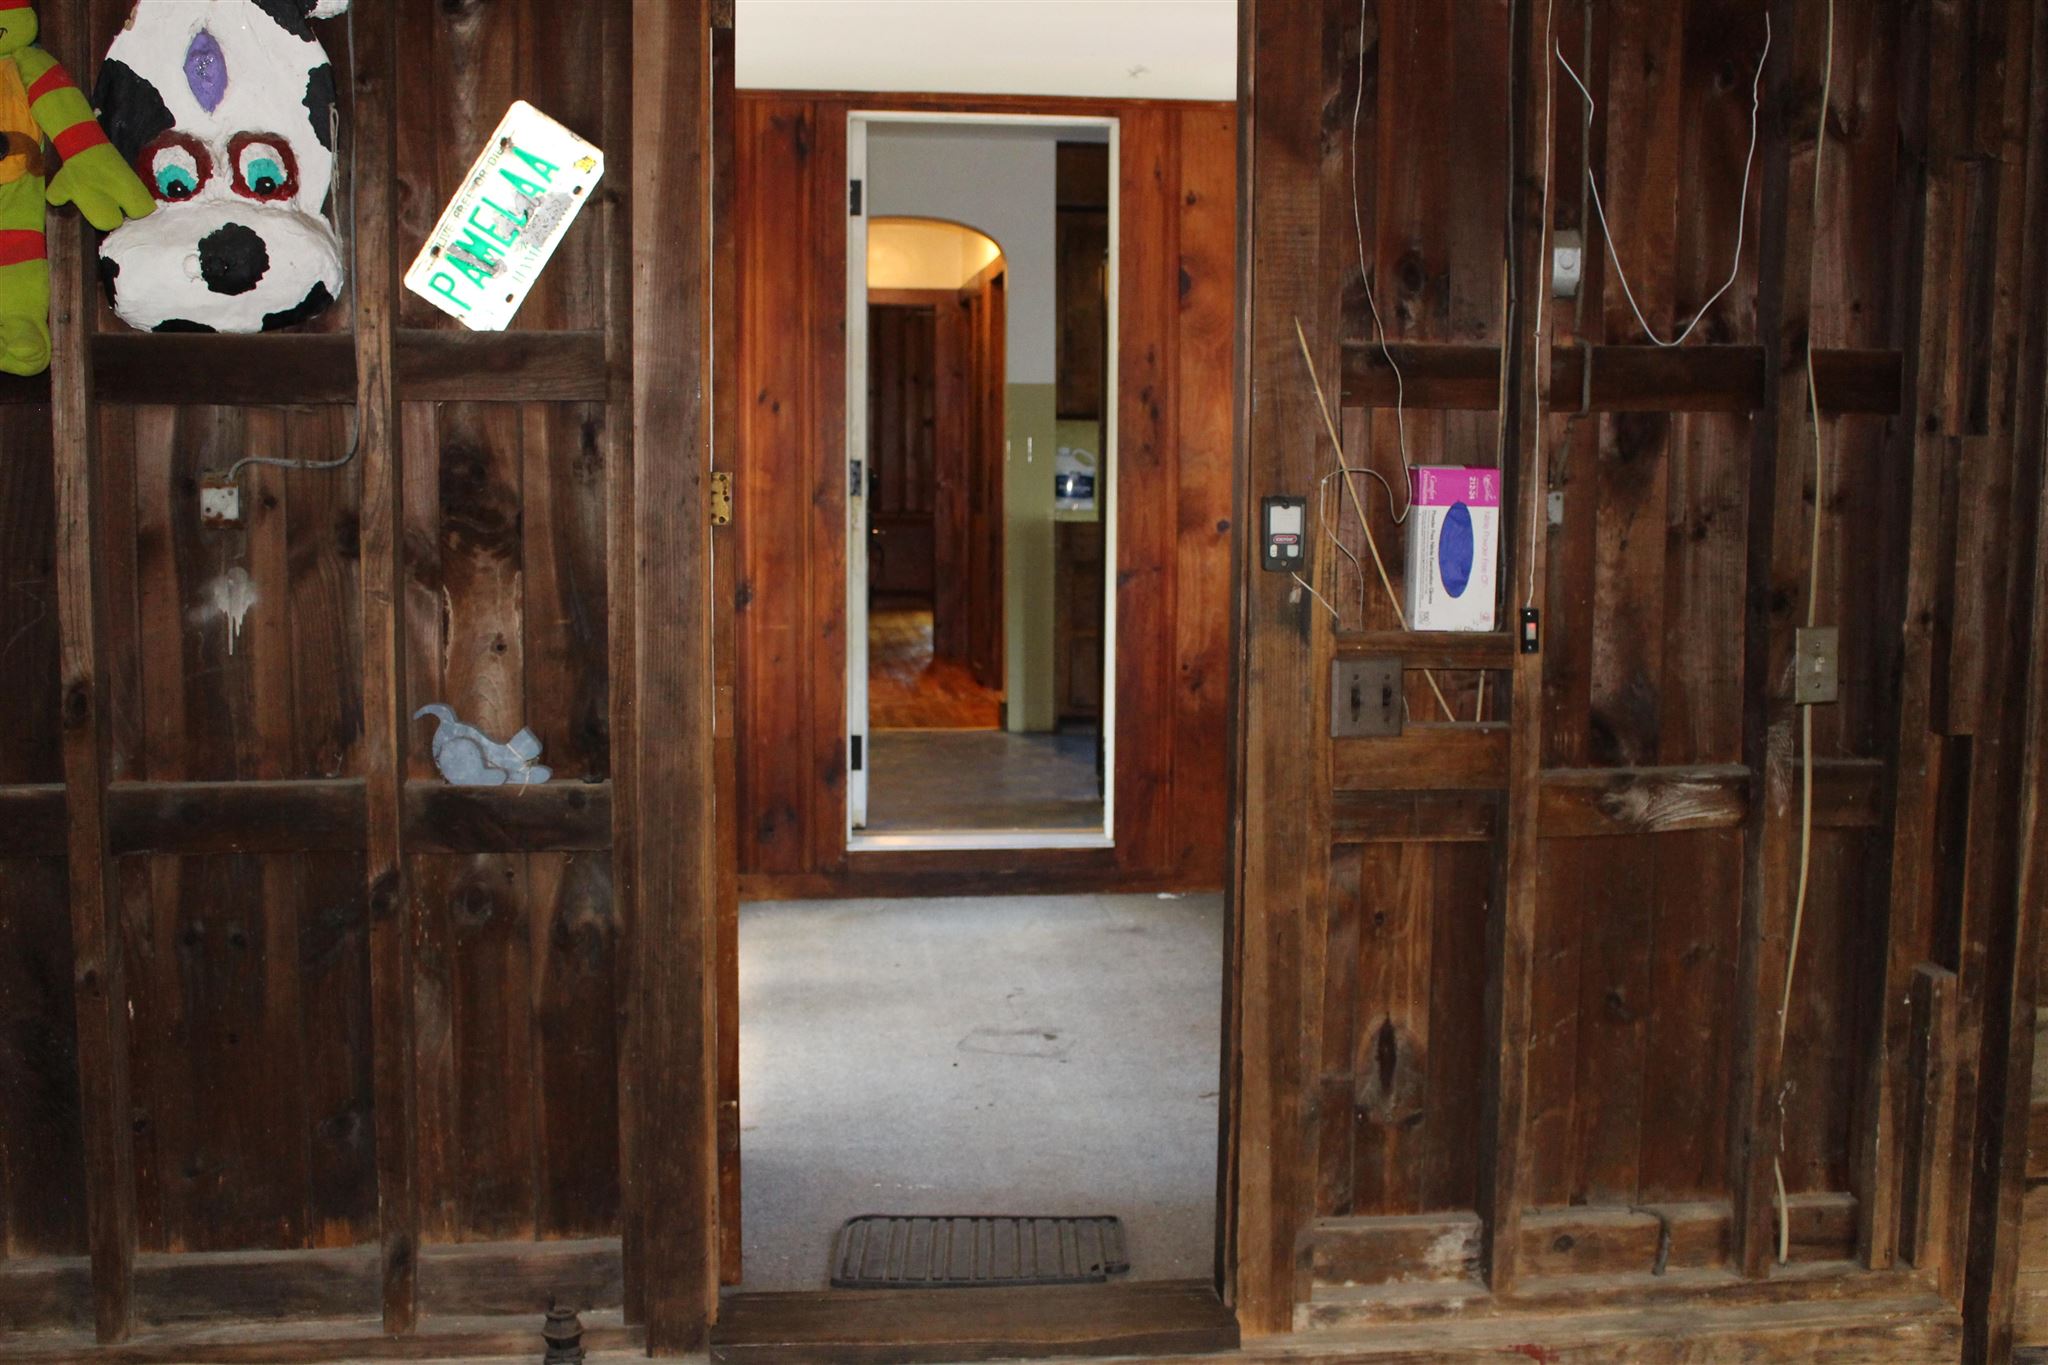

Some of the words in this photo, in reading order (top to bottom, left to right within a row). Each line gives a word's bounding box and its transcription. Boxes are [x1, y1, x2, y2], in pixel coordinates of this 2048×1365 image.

[428, 146, 560, 311] PAMELAA
[453, 191, 476, 219] FREE
[473, 169, 488, 186] OR
